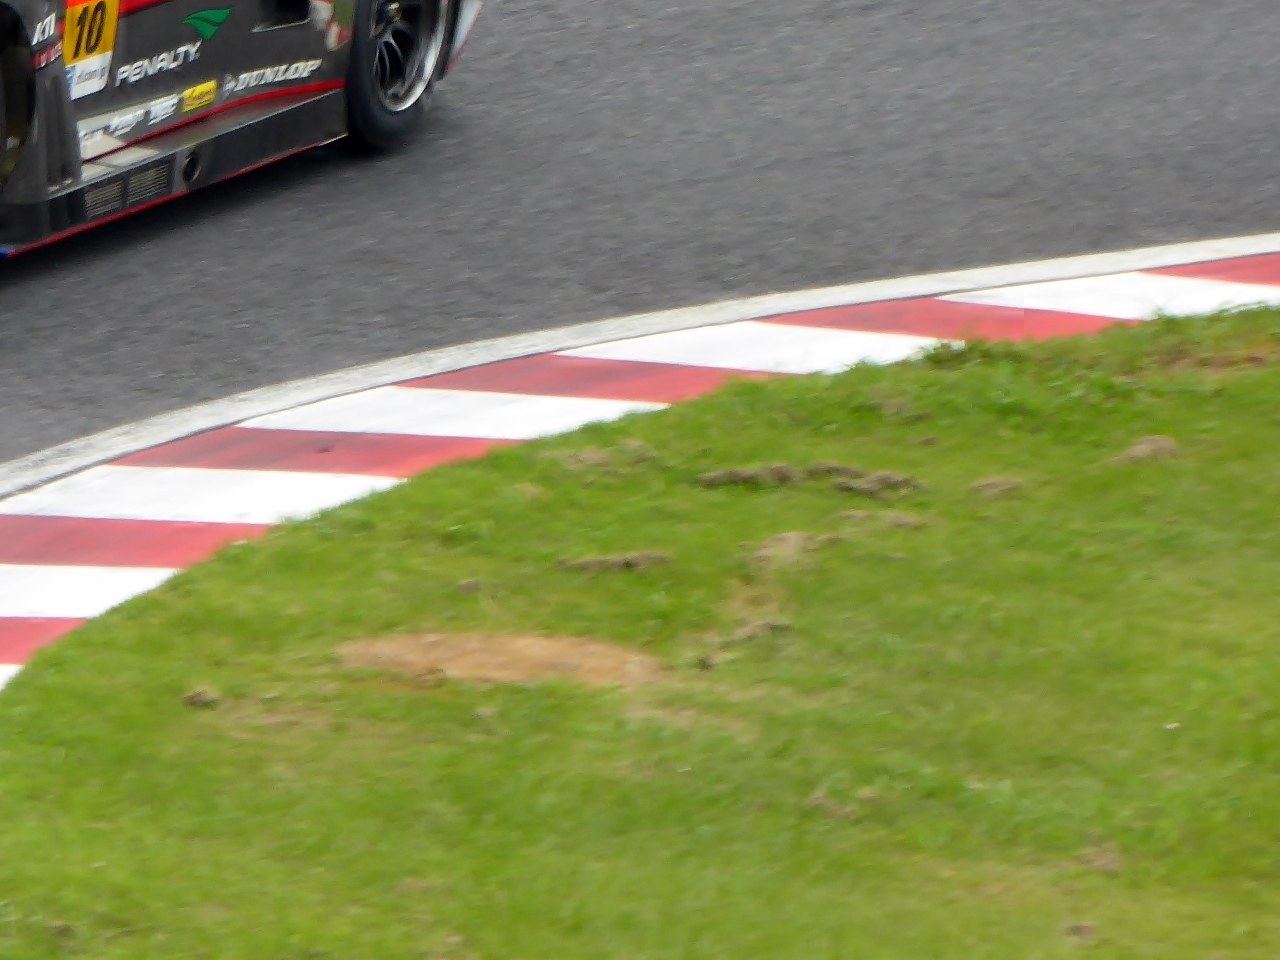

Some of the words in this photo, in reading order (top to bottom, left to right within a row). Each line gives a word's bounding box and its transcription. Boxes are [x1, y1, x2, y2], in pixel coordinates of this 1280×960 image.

[72, 0, 106, 60] 10
[114, 39, 202, 87] PENALTY
[234, 58, 322, 92] DUNLOP
